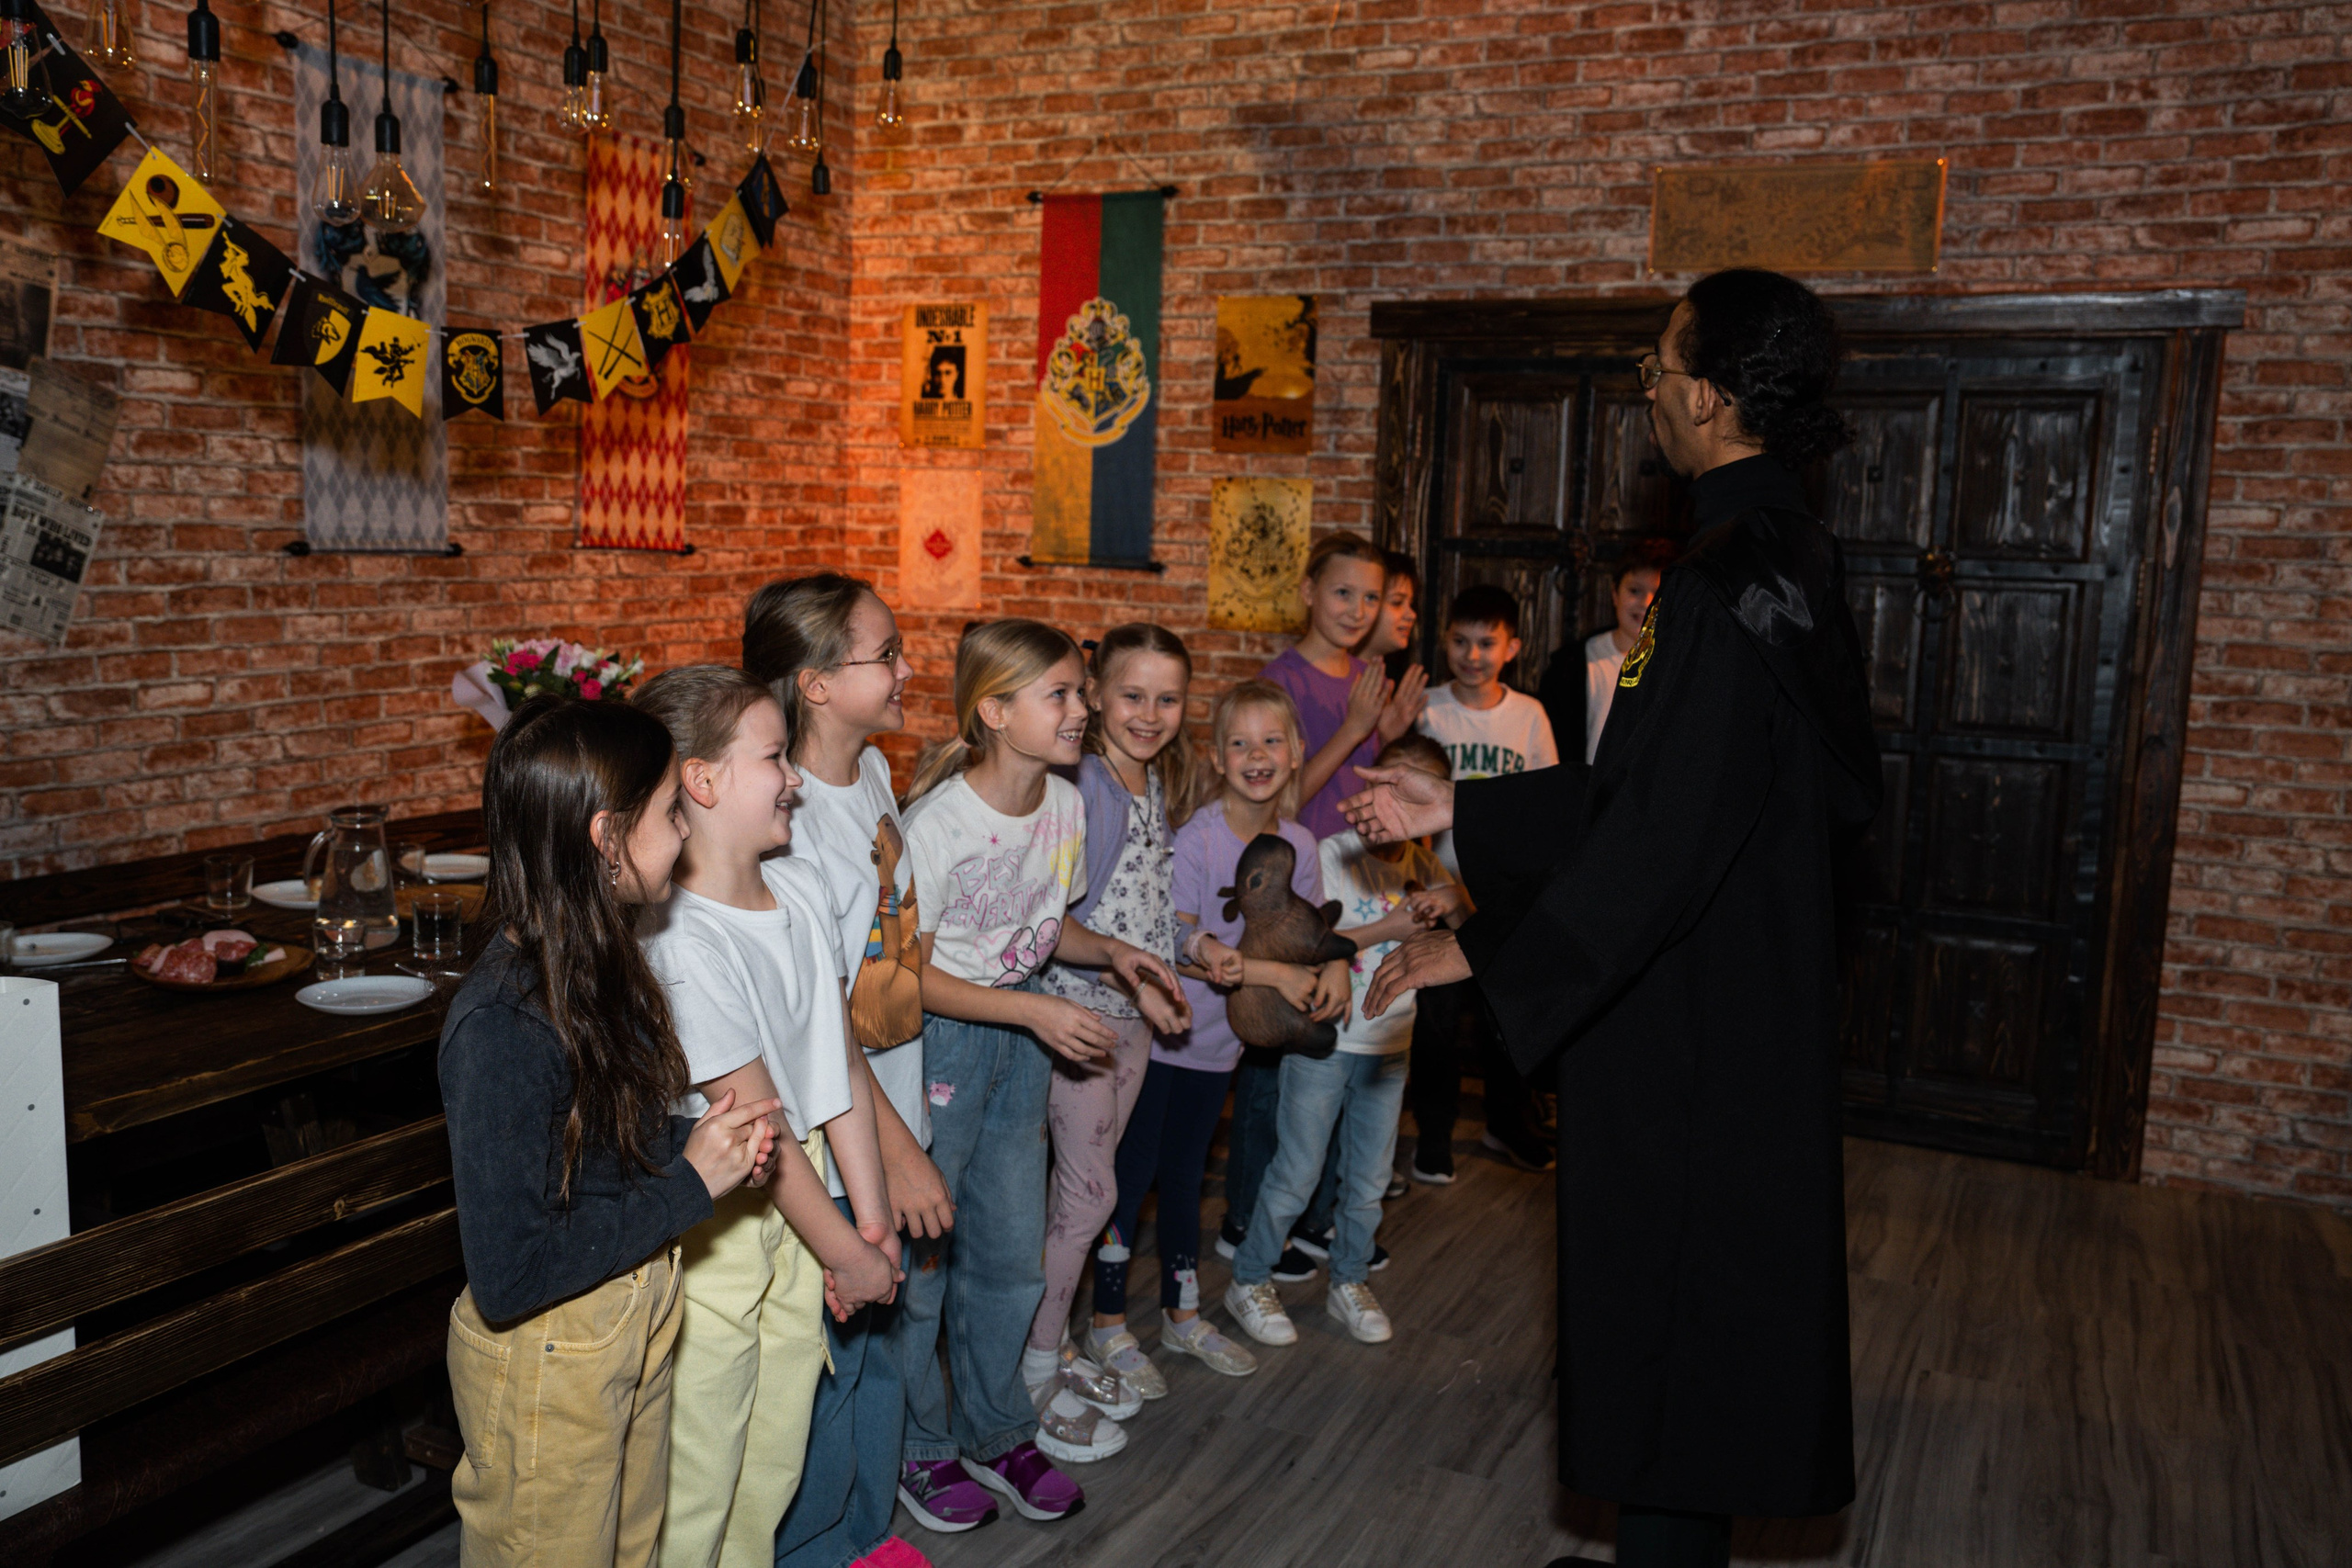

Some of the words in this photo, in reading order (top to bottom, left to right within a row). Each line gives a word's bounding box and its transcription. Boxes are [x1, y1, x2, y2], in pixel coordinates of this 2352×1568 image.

[954, 330, 963, 344] 1
[913, 400, 938, 416] HARRY
[943, 401, 972, 416] POTTER
[1222, 414, 1259, 439] Harry
[1262, 411, 1307, 441] Potter
[1443, 742, 1525, 775] UMMER
[950, 844, 1030, 901] BEST
